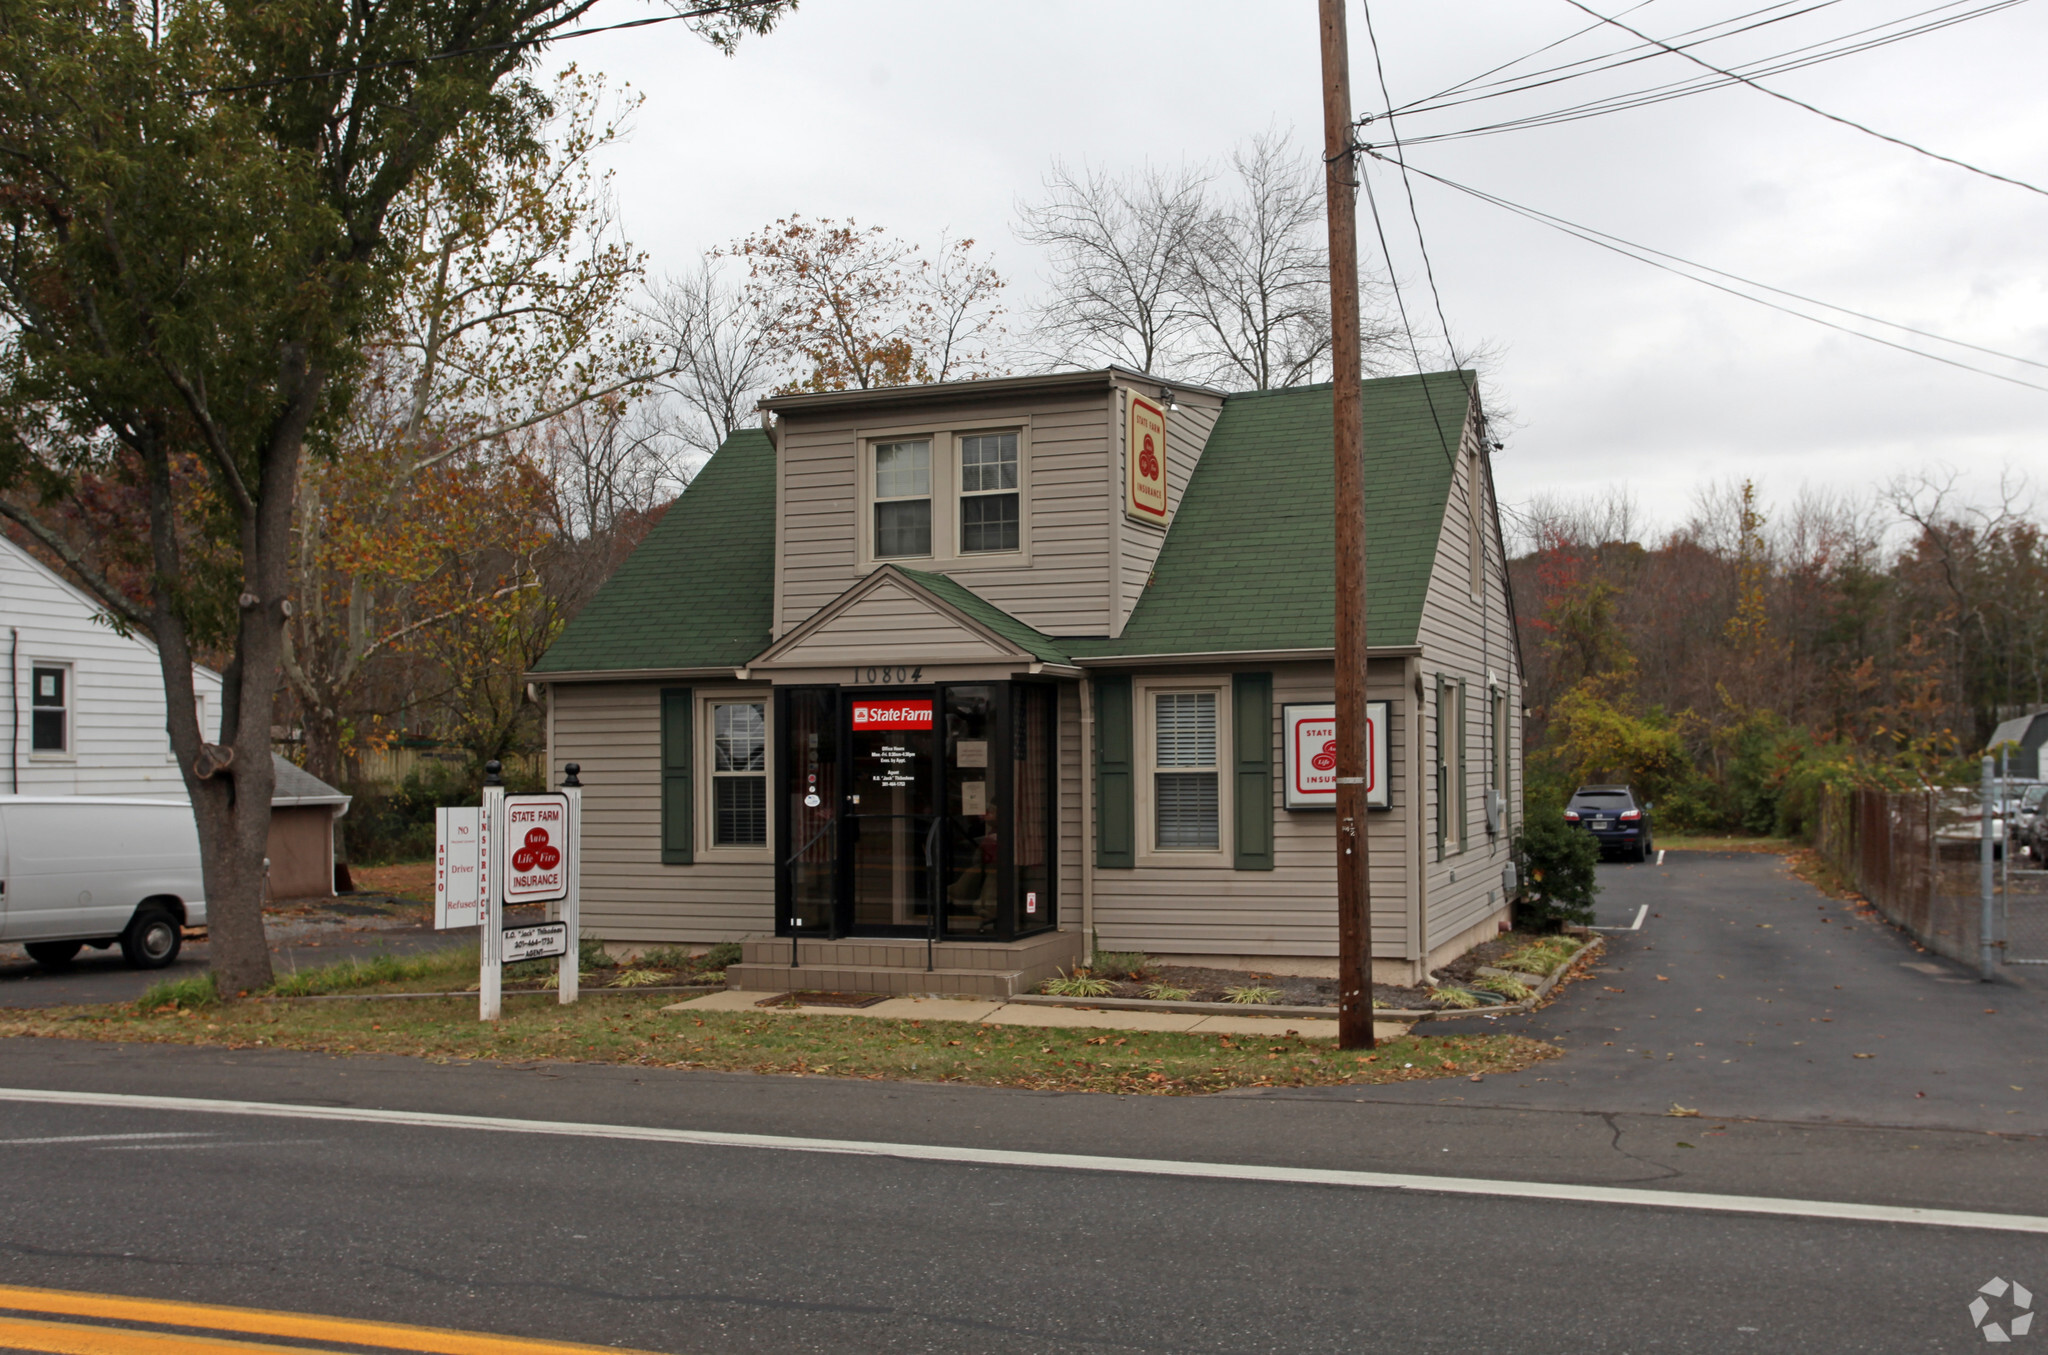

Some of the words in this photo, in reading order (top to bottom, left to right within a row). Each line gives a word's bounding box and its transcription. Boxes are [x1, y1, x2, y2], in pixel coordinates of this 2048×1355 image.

[1136, 414, 1148, 428] STATE
[1149, 420, 1161, 434] FARM
[1136, 482, 1162, 499] INSURANCE
[854, 666, 923, 684] 10804
[511, 810, 535, 823] STATE
[538, 810, 560, 822] FARM
[457, 826, 469, 835] NO
[529, 833, 546, 843] Auto
[517, 853, 534, 864] Life
[540, 851, 556, 862] Fire
[451, 864, 475, 874] Driver
[513, 873, 558, 888] INSURANCE
[447, 899, 477, 910] Refused
[525, 948, 543, 957] AGENT
